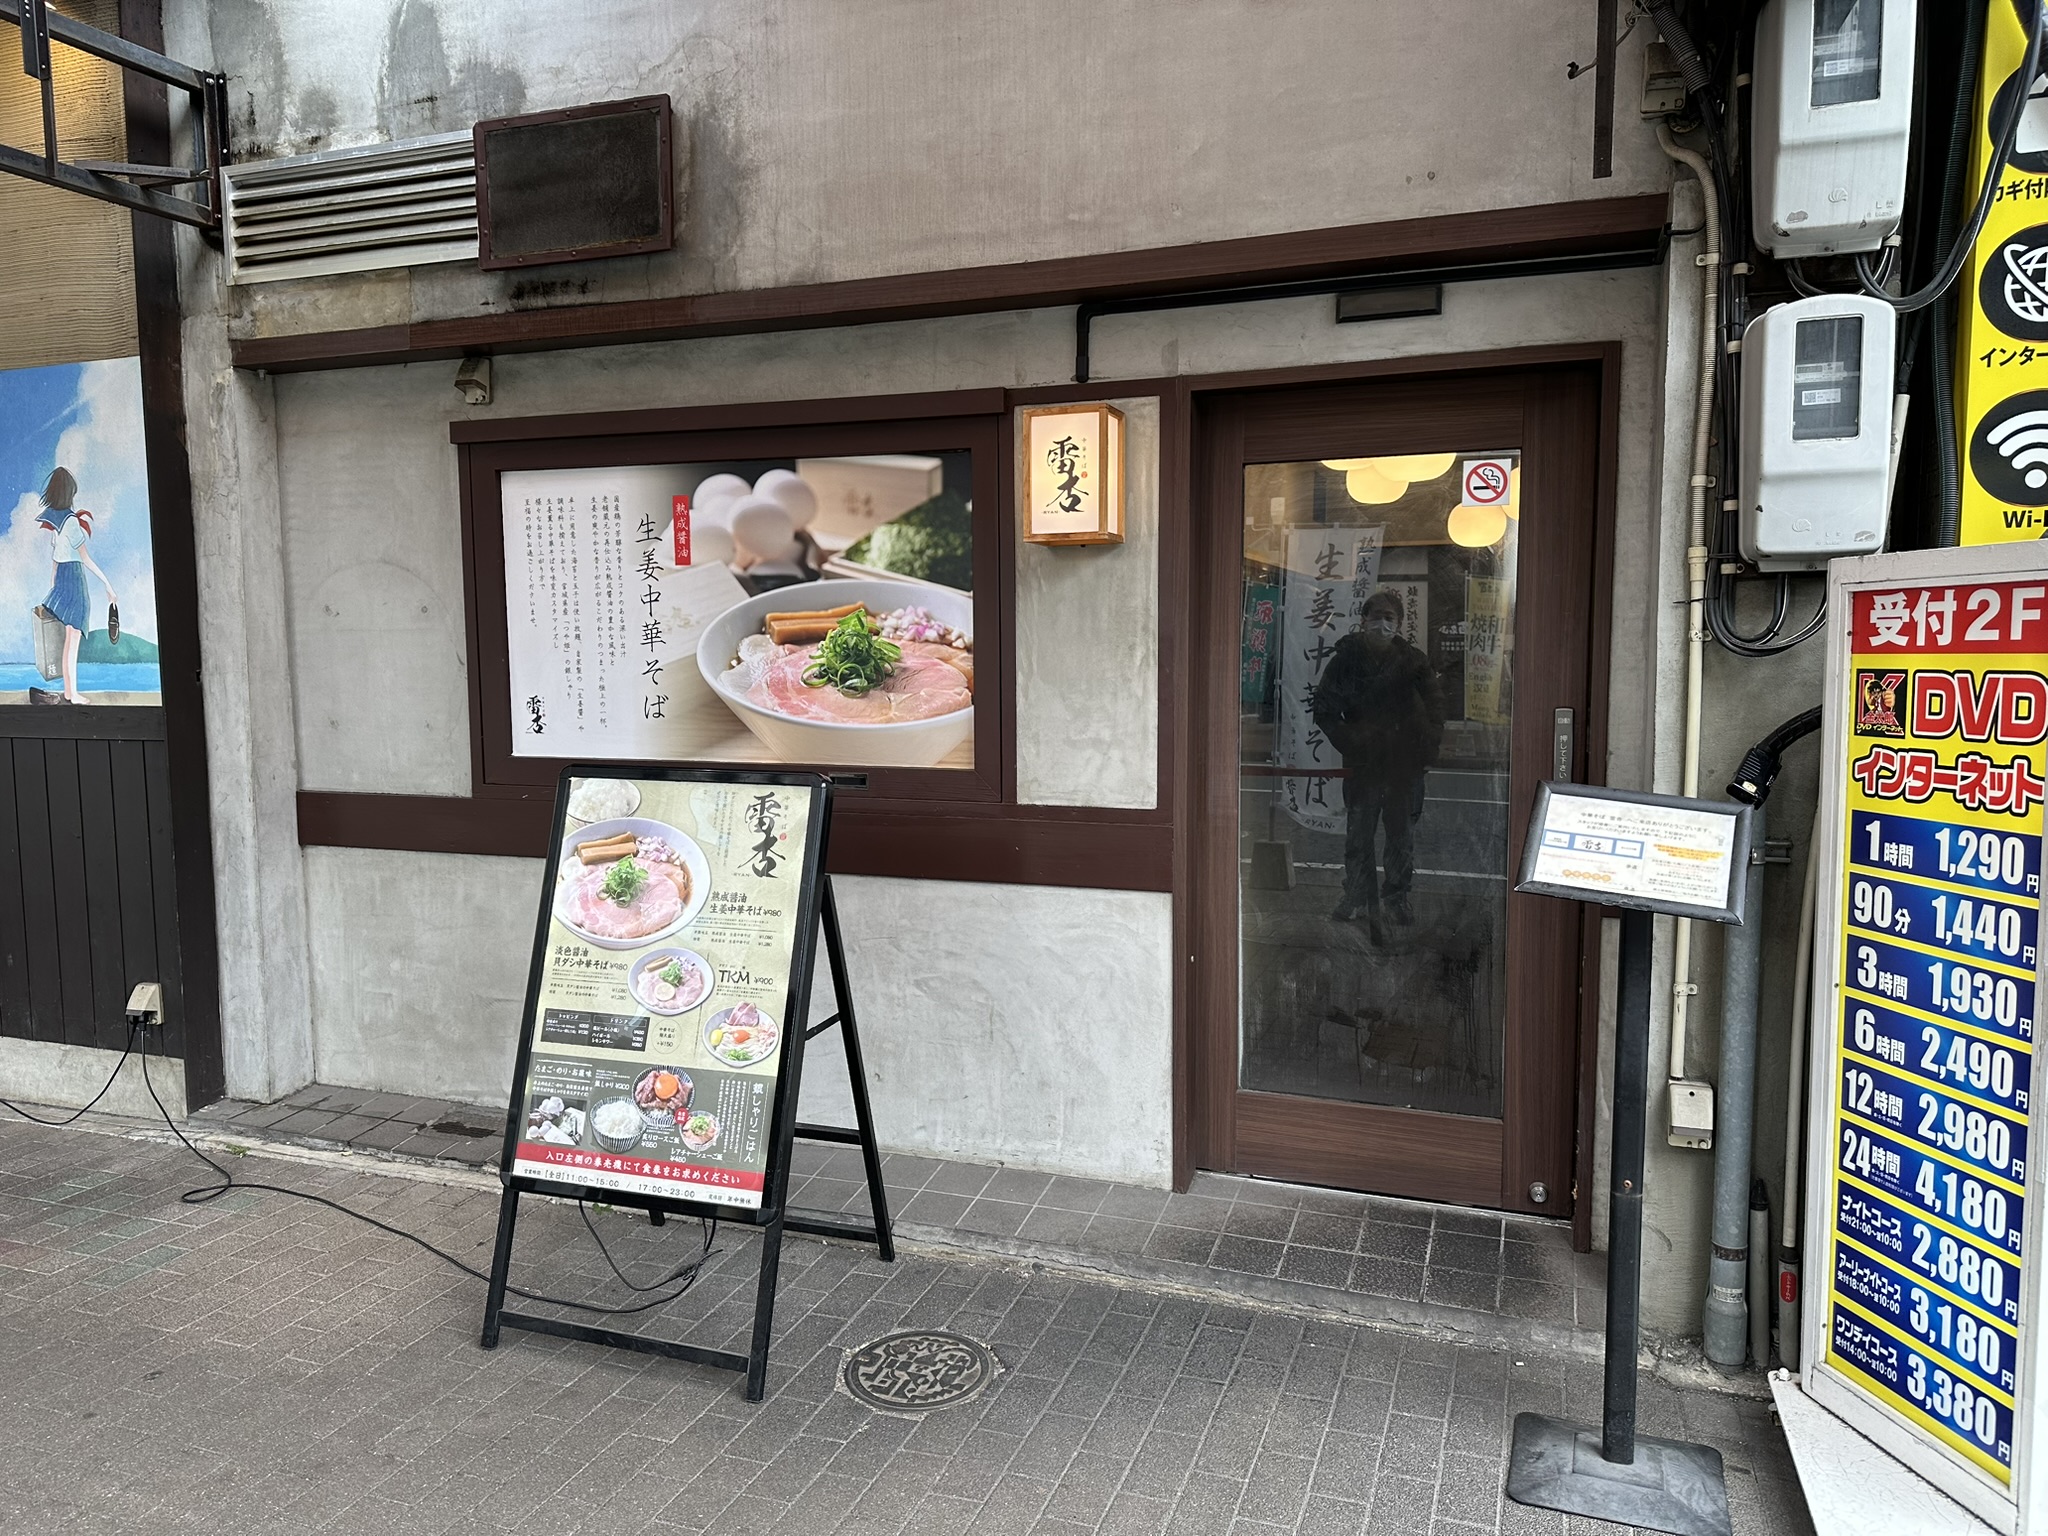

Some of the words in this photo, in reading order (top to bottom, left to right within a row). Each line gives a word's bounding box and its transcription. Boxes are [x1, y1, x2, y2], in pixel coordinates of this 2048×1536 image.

[635, 513, 669, 719] 生姜中華そば
[1869, 587, 2046, 647] 受付2F
[1913, 669, 2048, 744] DVD
[1559, 735, 1568, 779] 押して下さい
[1853, 747, 2046, 814] インターネット
[1865, 819, 1914, 870] 1時間
[1934, 827, 2040, 894] 1,290円
[709, 903, 762, 916] 生姜中華そば
[763, 909, 782, 917] ¥980
[711, 890, 747, 903] 熟成醤油
[1853, 881, 1912, 935] 90分
[1931, 894, 2036, 965] 1,440円
[553, 957, 608, 970] 貝ダシ中華そば
[609, 962, 628, 971] ¥980
[555, 945, 589, 957] 淡色醤油
[718, 969, 750, 984] TKM
[753, 976, 773, 985] ¥900
[1857, 945, 1909, 1001] 3時間
[1927, 961, 2032, 1038] 1,930円
[1854, 1008, 1905, 1066] 6時間
[1920, 1026, 2028, 1110] 2,490円
[744, 1082, 764, 1163] 銀しゃりごはん
[1845, 1068, 1903, 1121] 12時間
[1917, 1093, 2024, 1180] 2,980円
[545, 1150, 740, 1185] 入口左側の券売機にて食券をお求めください
[1842, 1128, 1900, 1178] 24時間
[1914, 1162, 2021, 1252] 4,180円
[1842, 1194, 1902, 1238] ナイトコース
[1911, 1222, 2017, 1321] 2,880円
[1839, 1252, 1901, 1302] アーリーナイトコース
[1909, 1287, 2014, 1391] 3,180円
[1836, 1314, 1898, 1368] ワンデイコース
[1906, 1353, 2011, 1462] 3,380円
